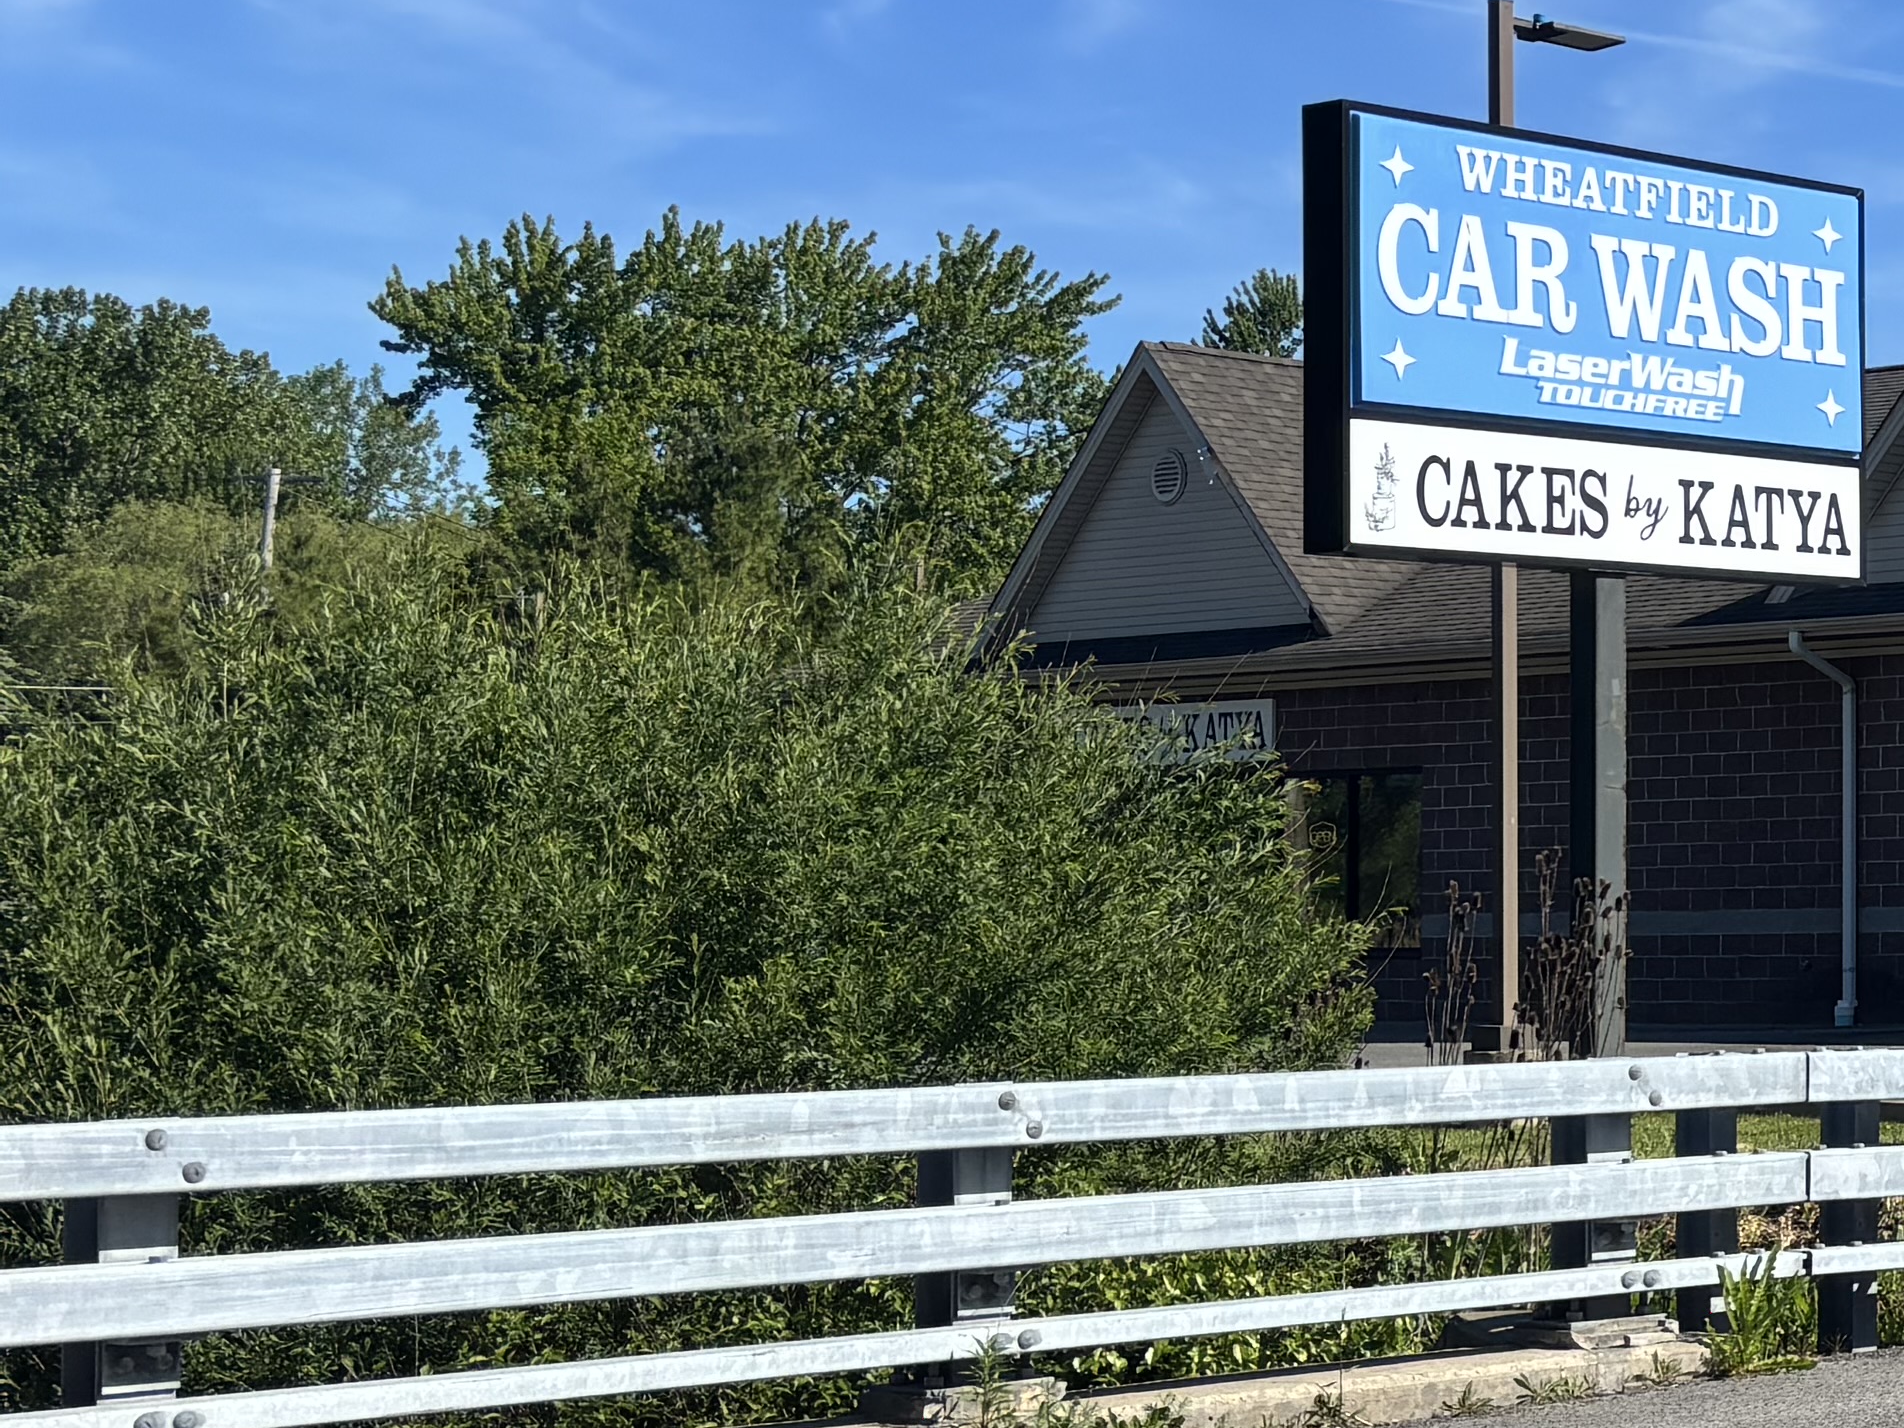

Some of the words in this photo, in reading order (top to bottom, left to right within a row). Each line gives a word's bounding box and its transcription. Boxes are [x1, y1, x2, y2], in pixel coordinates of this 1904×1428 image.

[1455, 143, 1779, 238] WHEATFIELD
[1377, 202, 1577, 335] CAR
[1589, 232, 1847, 366] WASH
[1499, 335, 1745, 415] LaserWash
[1537, 381, 1726, 422] TOUCHFREE
[1416, 454, 1609, 539] CAKES
[1624, 474, 1668, 539] by
[1679, 479, 1852, 556] KATYA
